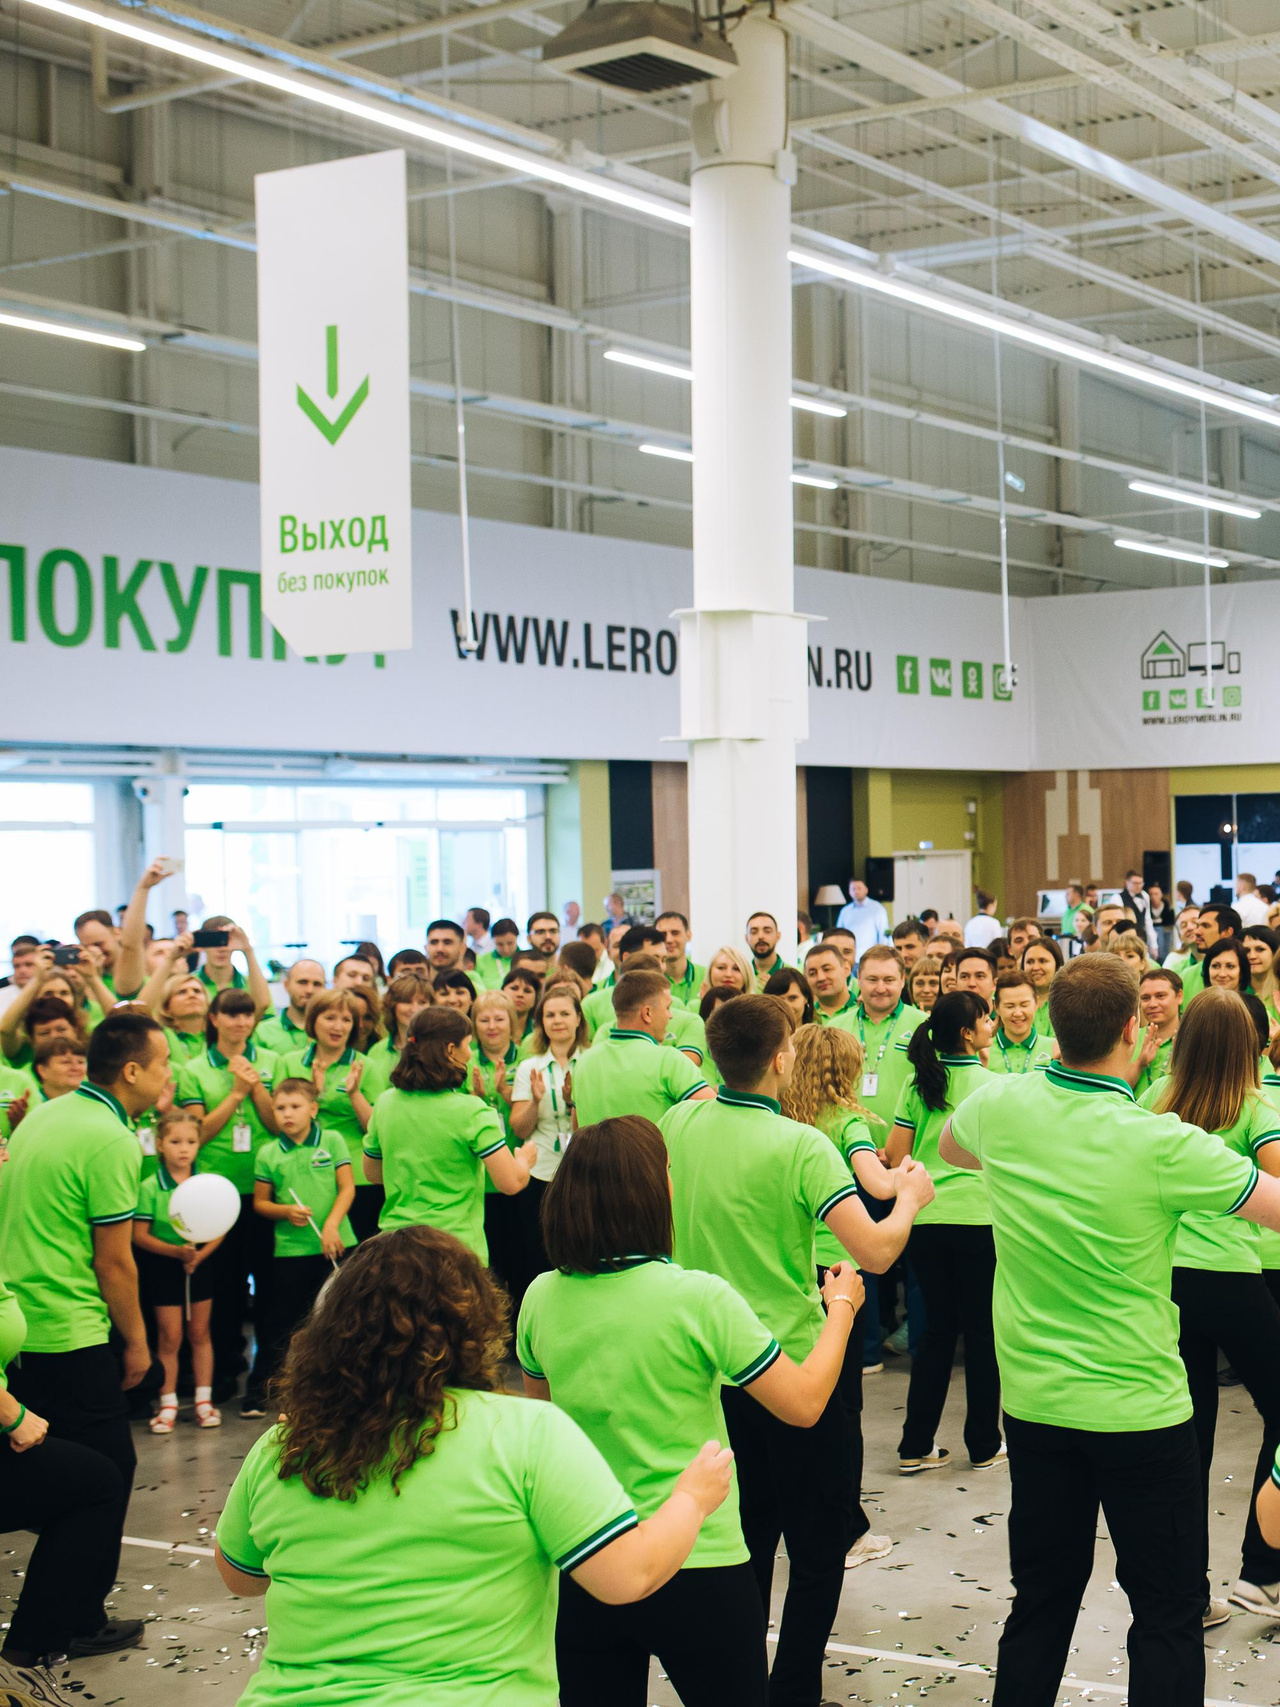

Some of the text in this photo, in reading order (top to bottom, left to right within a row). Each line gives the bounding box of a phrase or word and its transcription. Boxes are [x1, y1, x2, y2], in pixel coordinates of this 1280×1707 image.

[279, 515, 389, 554] Выход
[277, 568, 389, 594] без покупок
